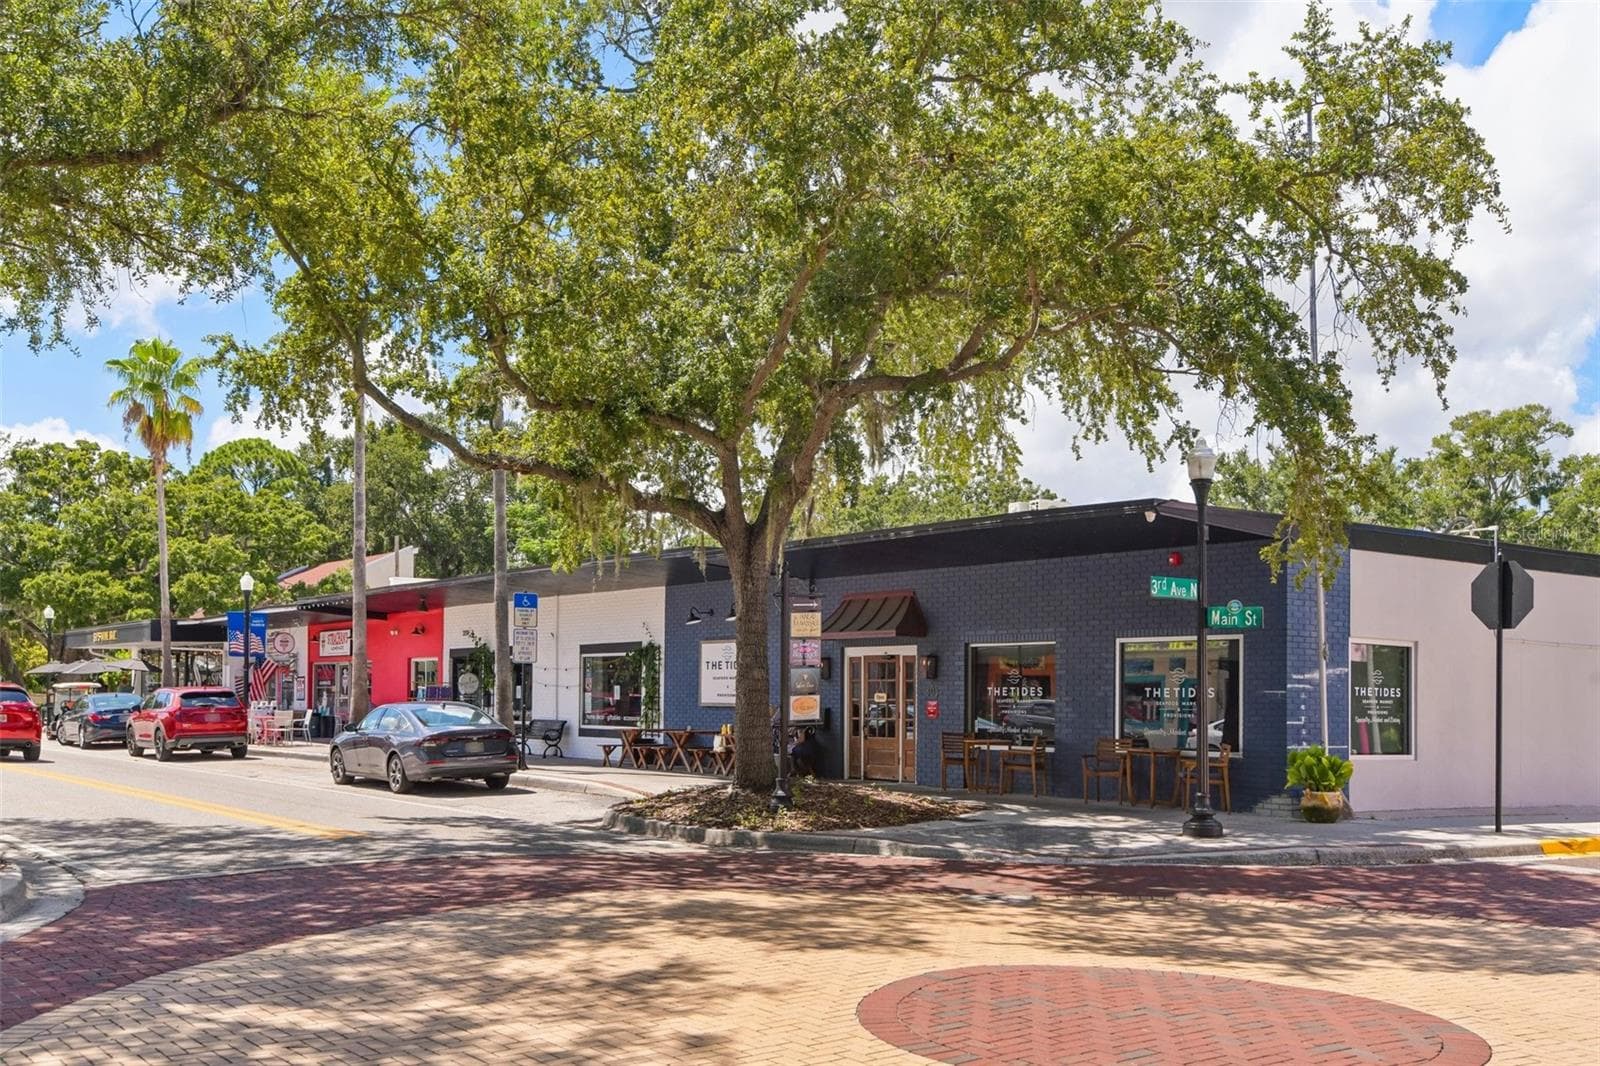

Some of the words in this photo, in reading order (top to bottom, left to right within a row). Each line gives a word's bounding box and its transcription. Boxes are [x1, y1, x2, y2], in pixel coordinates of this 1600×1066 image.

[1151, 577, 1167, 594] 3rd
[1170, 582, 1187, 597] Ave
[1190, 582, 1198, 597] N
[1211, 610, 1238, 625] Main
[1245, 610, 1257, 626] St
[705, 661, 723, 670] THE
[1173, 687, 1216, 698] TIDS
